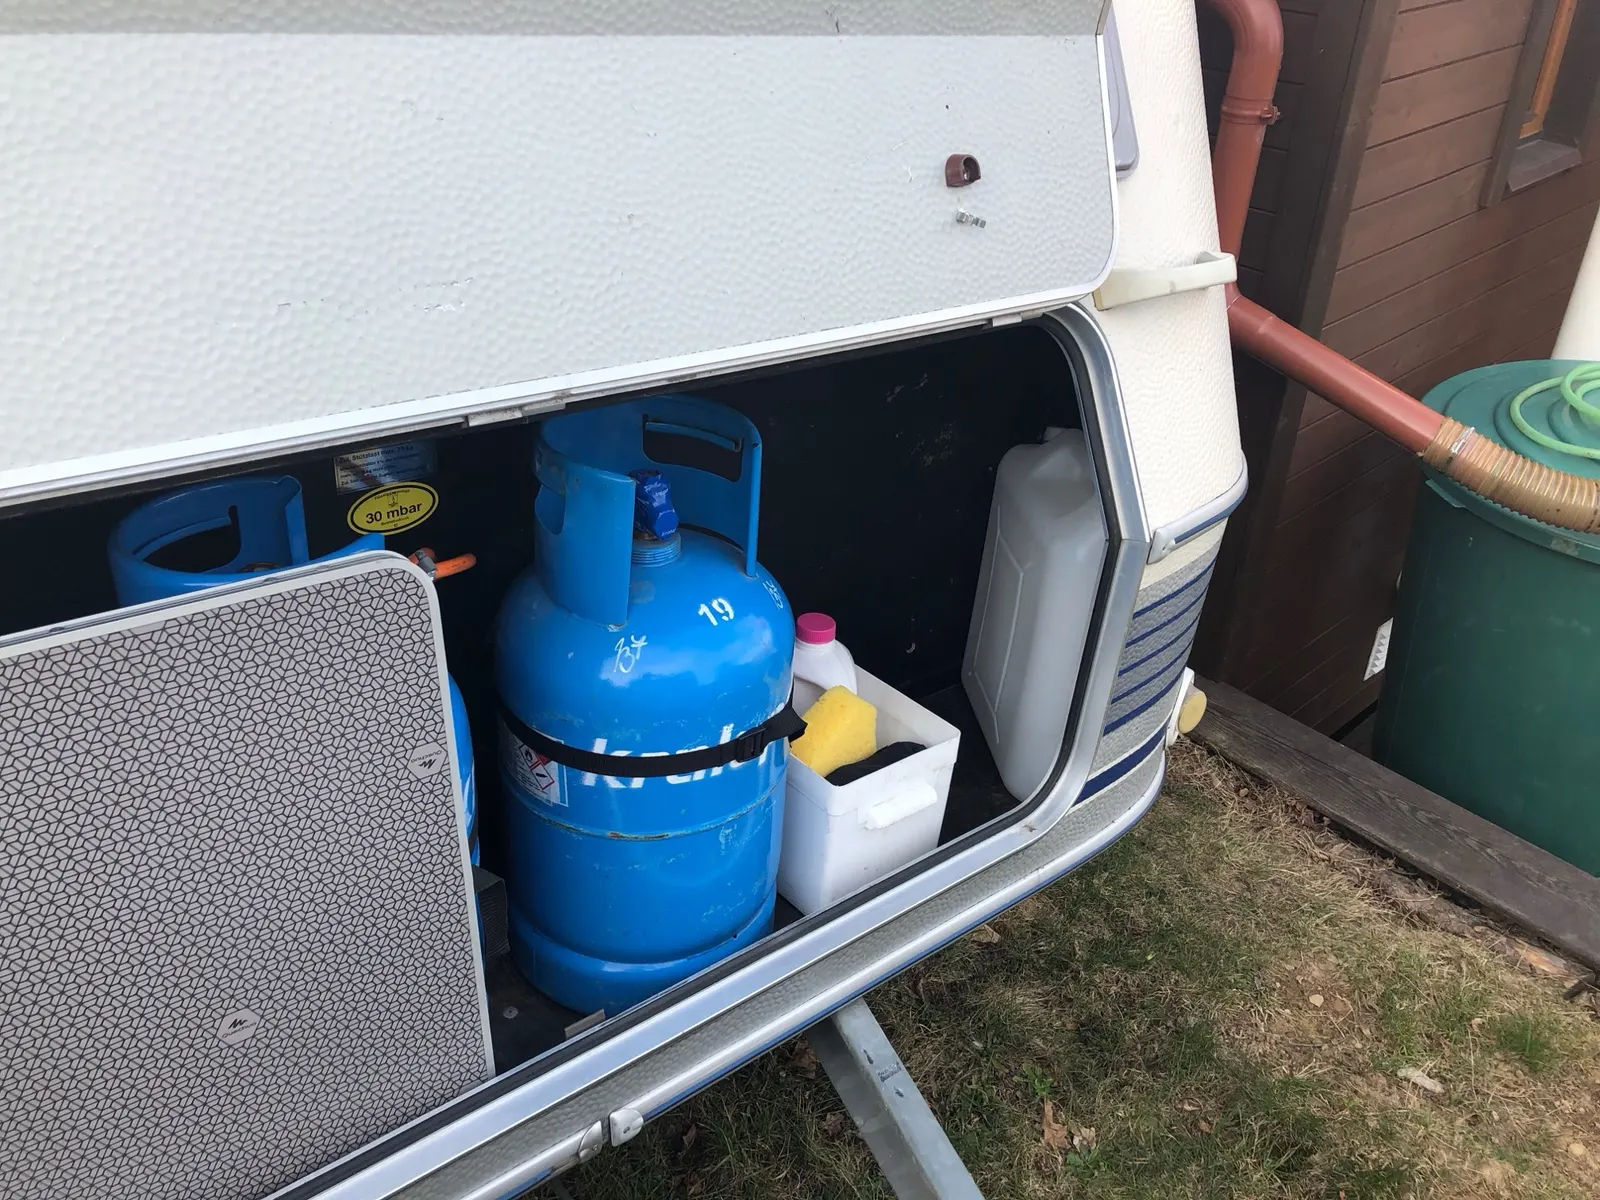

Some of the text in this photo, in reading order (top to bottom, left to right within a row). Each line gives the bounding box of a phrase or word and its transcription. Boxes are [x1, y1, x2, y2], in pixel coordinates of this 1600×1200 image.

[365, 503, 422, 524] 30 mbar
[698, 597, 735, 626] 19
